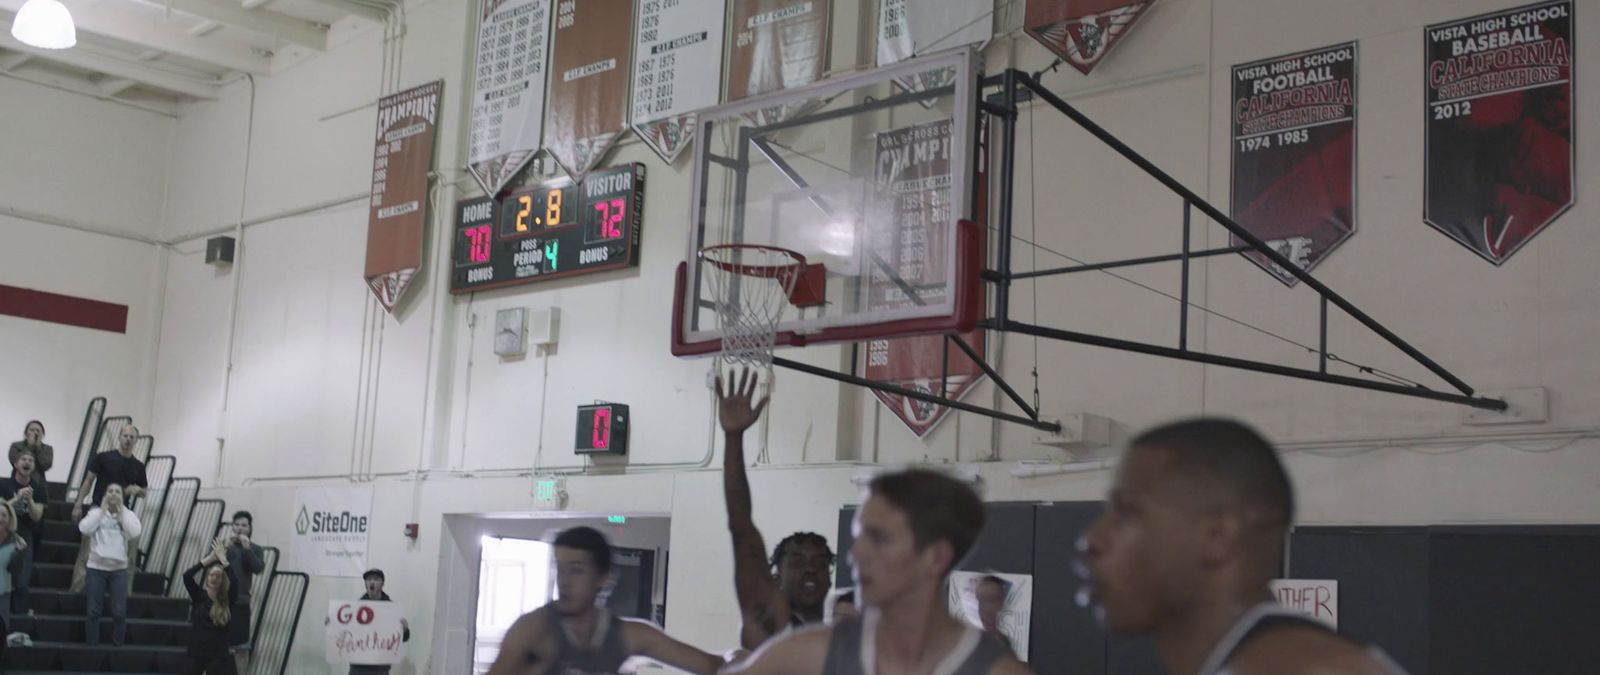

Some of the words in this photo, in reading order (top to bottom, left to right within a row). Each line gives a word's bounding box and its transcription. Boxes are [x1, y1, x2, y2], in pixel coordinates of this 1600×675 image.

[1431, 26, 1467, 42] VISTA
[1471, 17, 1506, 35] HIGH
[1510, 5, 1568, 27] SCHOOL
[1452, 25, 1544, 56] BASEBALL
[1237, 66, 1268, 81] VISTA
[1271, 59, 1300, 75] HIGH
[1304, 49, 1352, 68] SCHOOL
[1429, 37, 1569, 89] CALIFORNIA
[656, 83, 673, 98] 2011
[1253, 66, 1334, 94] FOOTBALL
[1438, 76, 1480, 100] STATE
[1479, 66, 1560, 92] CHAMPIONS
[1235, 78, 1353, 124] CALIFORNIA
[1434, 101, 1471, 120] 2012
[377, 93, 437, 140] CHAMPIONS
[1242, 113, 1277, 135] STATE
[1277, 104, 1345, 129] CHAMPIONS
[908, 124, 939, 141] CROSS
[1240, 136, 1271, 152] 1974
[1278, 129, 1309, 146] 1985
[586, 172, 631, 198] VISITOR
[462, 202, 493, 223] HOME
[516, 188, 562, 232] 2.8
[594, 198, 626, 239] 72
[464, 224, 491, 263] 70
[521, 238, 537, 251] POSS
[545, 241, 558, 270] 4
[579, 246, 609, 264] BONUS
[513, 249, 543, 267] PERIOD
[467, 267, 494, 283] BONUS
[592, 408, 610, 449] 0
[312, 510, 367, 533] SiteOne
[337, 604, 375, 625] GO
